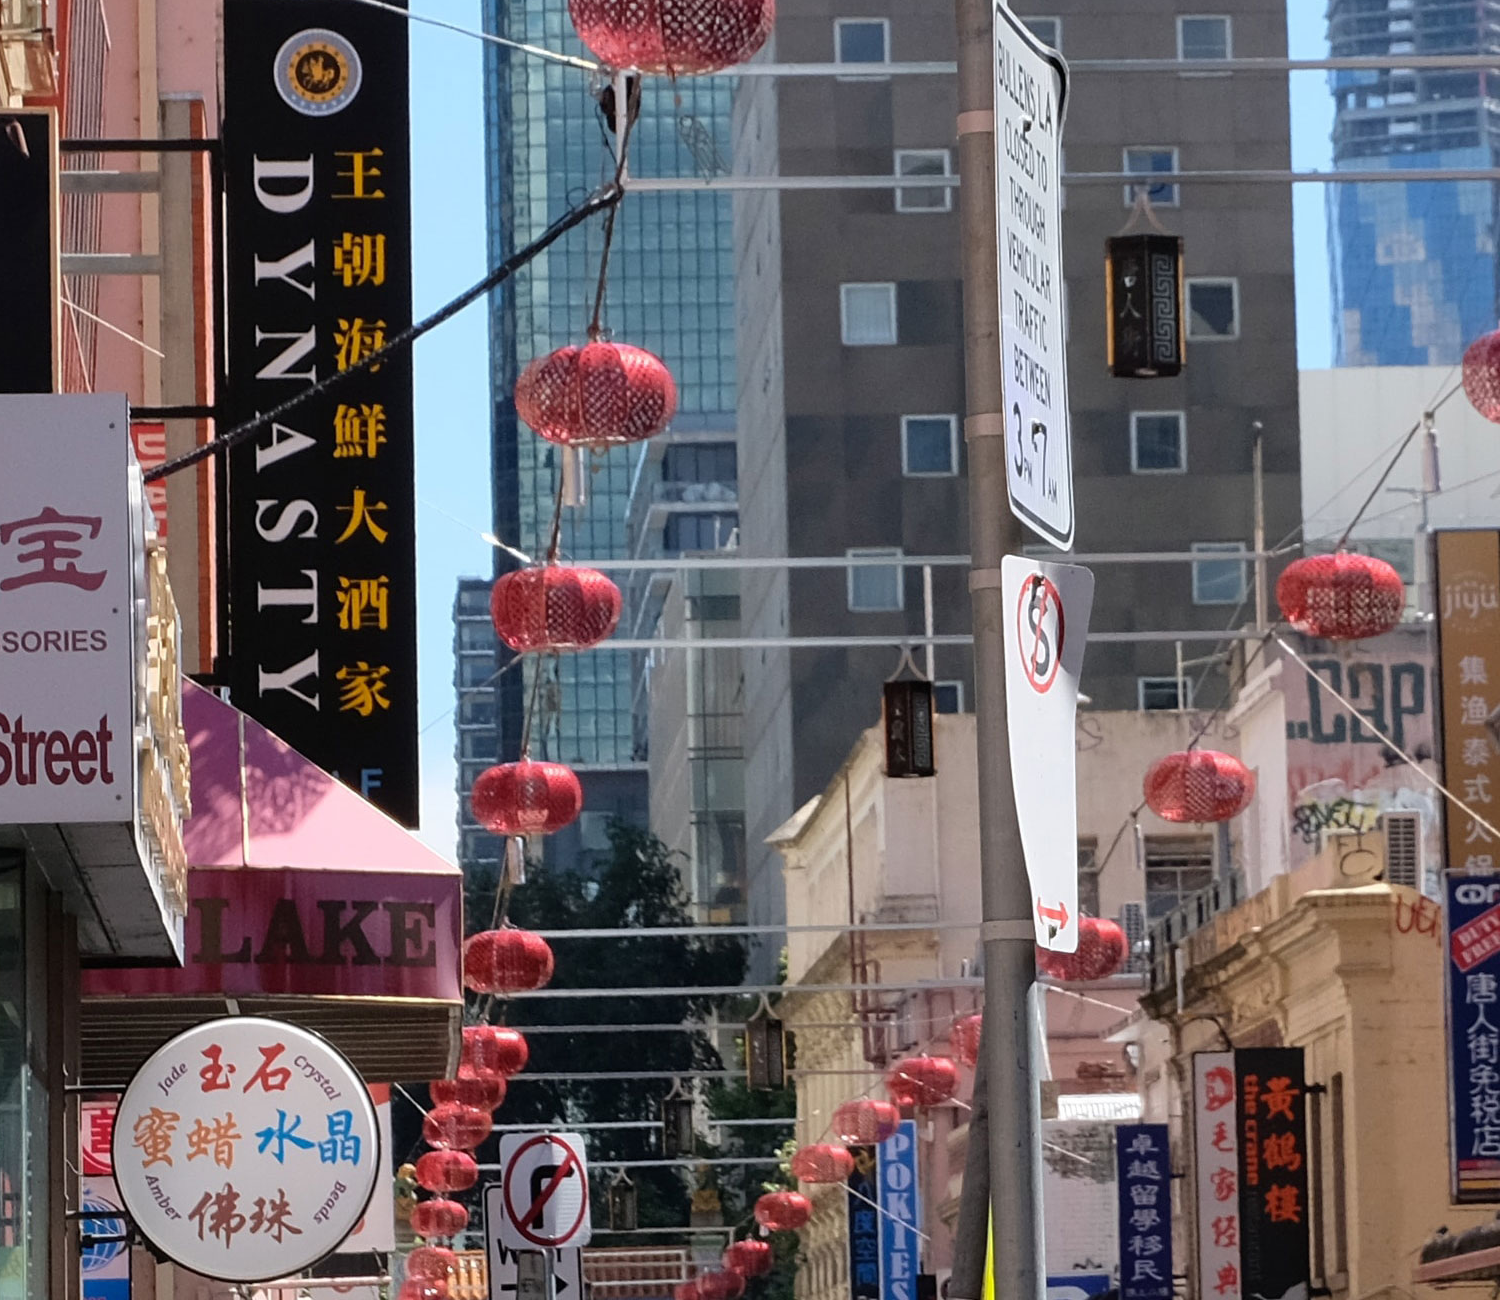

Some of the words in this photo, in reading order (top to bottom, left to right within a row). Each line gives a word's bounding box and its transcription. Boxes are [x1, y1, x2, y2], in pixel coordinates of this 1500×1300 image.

[997, 39, 1035, 122] BULLENS
[1037, 83, 1053, 138] LA
[1004, 117, 1034, 180] CLOSED
[1036, 150, 1048, 193] TO
[1009, 175, 1047, 246] THROUGH
[1006, 226, 1052, 304] VEHICULAR
[1013, 289, 1048, 353] TRAFFIC
[1013, 345, 1052, 410] BETWEEN
[252, 153, 321, 712] DYNASTY
[190, 898, 437, 966] LAKE
[156, 1060, 190, 1097] Jade
[198, 1042, 293, 1095] 玉石
[292, 1054, 343, 1102] Crystal
[131, 1106, 243, 1170] 蜜蜡
[254, 1108, 362, 1167] 水晶
[144, 1173, 183, 1223] Amber
[188, 1181, 304, 1250] 佛珠
[311, 1180, 348, 1225] Beads
